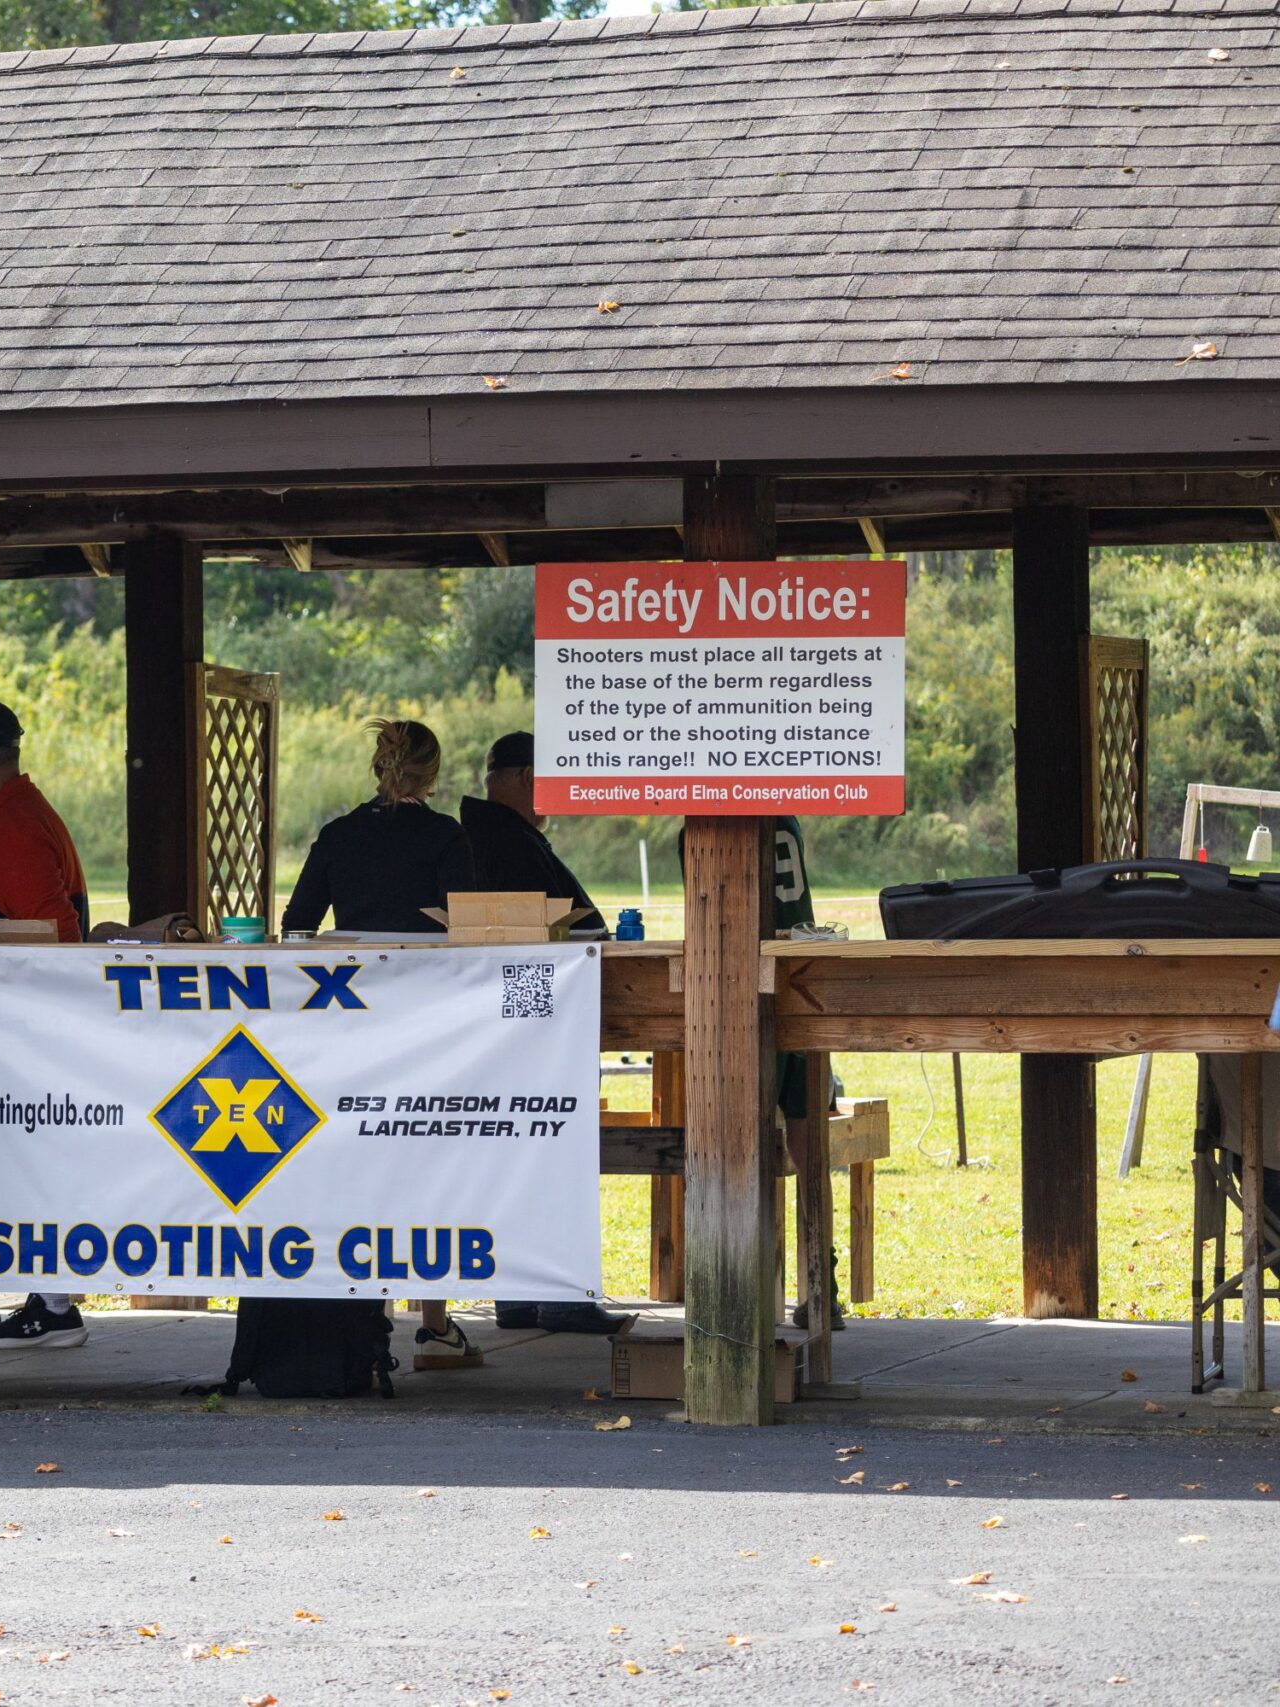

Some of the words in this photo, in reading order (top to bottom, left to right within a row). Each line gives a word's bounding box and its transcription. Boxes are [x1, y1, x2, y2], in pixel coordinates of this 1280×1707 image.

[566, 577, 703, 634] Safety
[718, 576, 870, 621] Notice:
[557, 647, 644, 664] Shooters
[650, 647, 698, 663] must
[704, 646, 756, 666] place
[761, 646, 784, 662] all
[789, 646, 858, 666] targets
[864, 646, 882, 661] at
[565, 674, 596, 690] the
[602, 674, 647, 690] base
[653, 673, 673, 689] of
[677, 673, 708, 689] the
[714, 673, 763, 689] berm
[769, 672, 873, 693] regardless
[565, 699, 585, 716] of
[589, 699, 620, 715] the
[625, 700, 667, 719] type
[672, 698, 693, 715] of
[697, 698, 812, 715] ammunition
[819, 698, 873, 718] being
[568, 726, 616, 742] used
[622, 729, 644, 742] or
[649, 725, 681, 742] the
[687, 725, 777, 745] shooting
[783, 725, 870, 741] distance
[556, 755, 580, 768] on
[585, 751, 622, 767] this
[628, 751, 695, 771] range!!
[708, 750, 738, 767] NO
[744, 750, 881, 767] EXCEPTIONS!
[569, 784, 641, 801] Executive
[644, 784, 688, 800] Board
[692, 784, 729, 800] Elma
[732, 784, 830, 800] Conservation
[833, 784, 868, 800] Club
[102, 963, 271, 1011] TEN
[296, 962, 369, 1011] X
[192, 1103, 284, 1125] TEN
[337, 1096, 387, 1113] 853
[394, 1096, 501, 1113] RANSOM
[508, 1096, 578, 1113] ROAD
[358, 1120, 520, 1138] LANCASTER,
[529, 1120, 566, 1137] NY
[335, 1224, 497, 1280] CLUB
